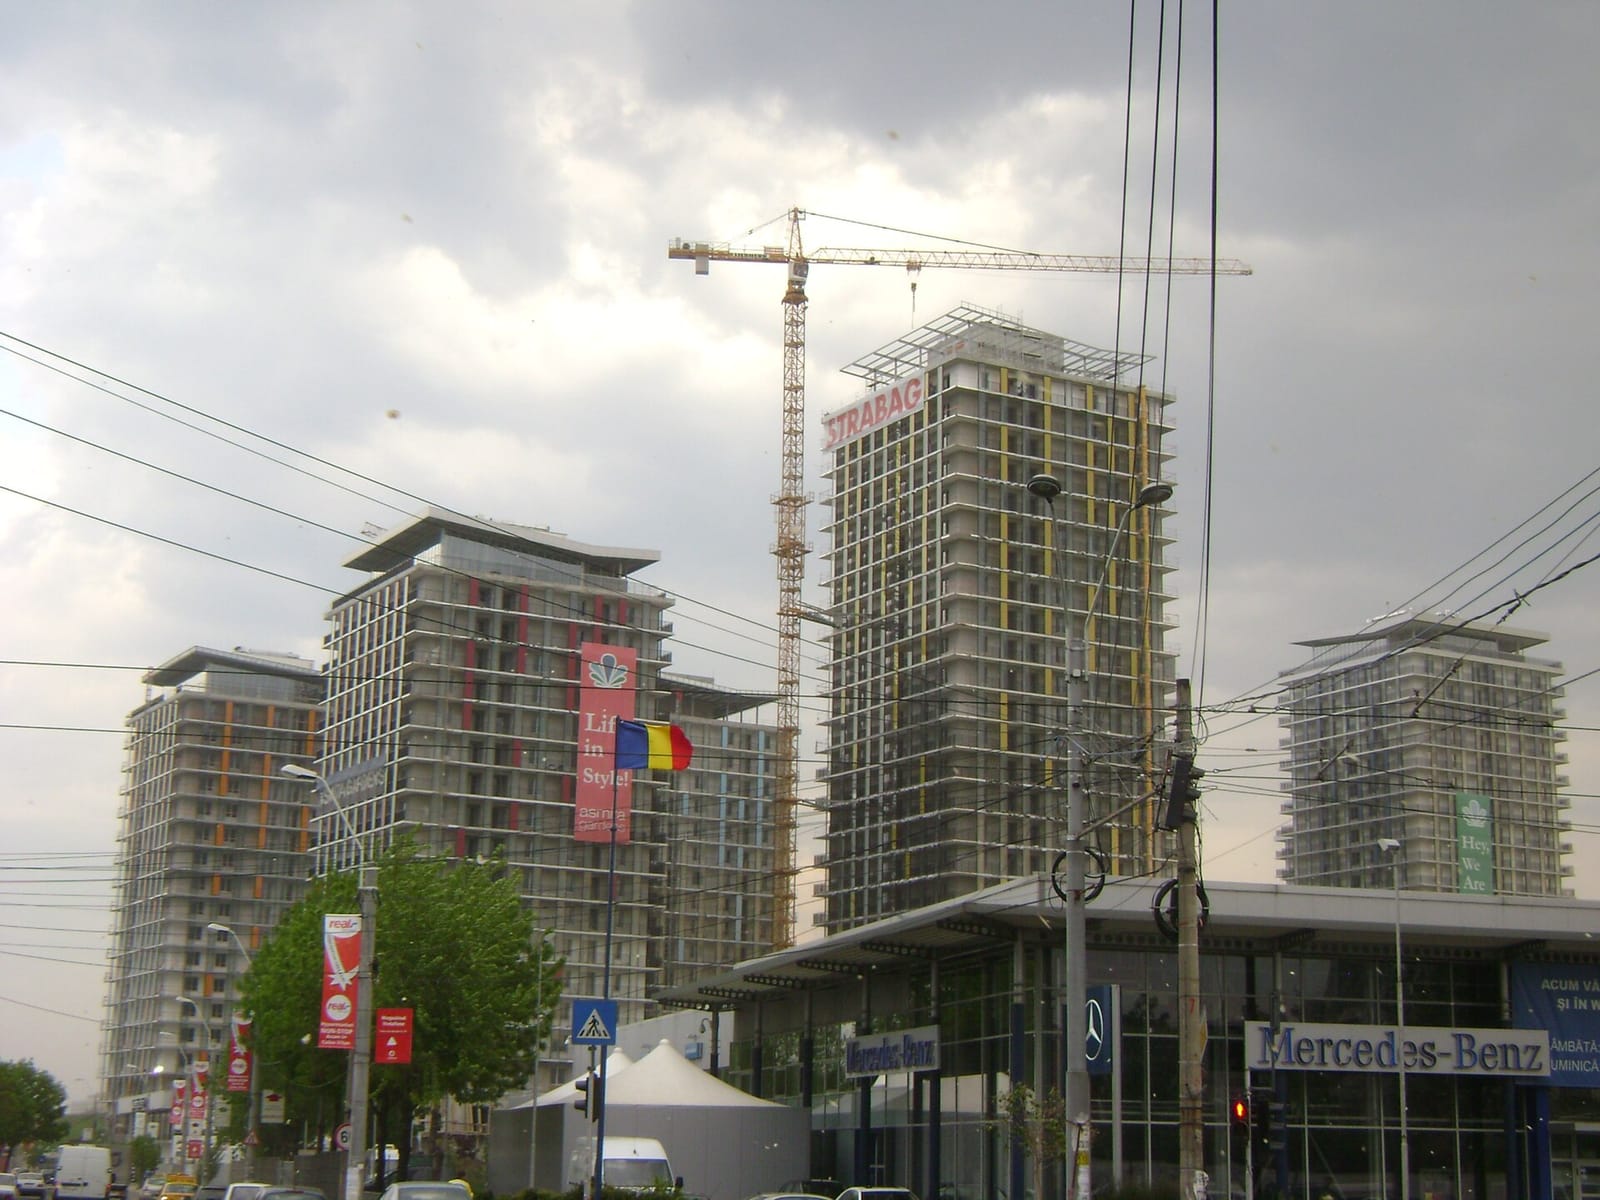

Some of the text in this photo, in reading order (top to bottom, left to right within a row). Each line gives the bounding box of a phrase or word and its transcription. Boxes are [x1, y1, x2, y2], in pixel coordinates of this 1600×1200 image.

[825, 378, 922, 449] STRABAG
[584, 708, 617, 734] Lif
[583, 738, 604, 758] in
[583, 767, 629, 789] Style!
[1462, 857, 1481, 872] We
[1463, 875, 1486, 891] Are
[1541, 979, 1579, 991] ACUM
[1591, 999, 1600, 1010] W
[1257, 1026, 1543, 1072] Mercedes-Benz
[1551, 1037, 1600, 1053] ÂMBĂTĂ:
[1551, 1057, 1600, 1073] UMINICĂ
